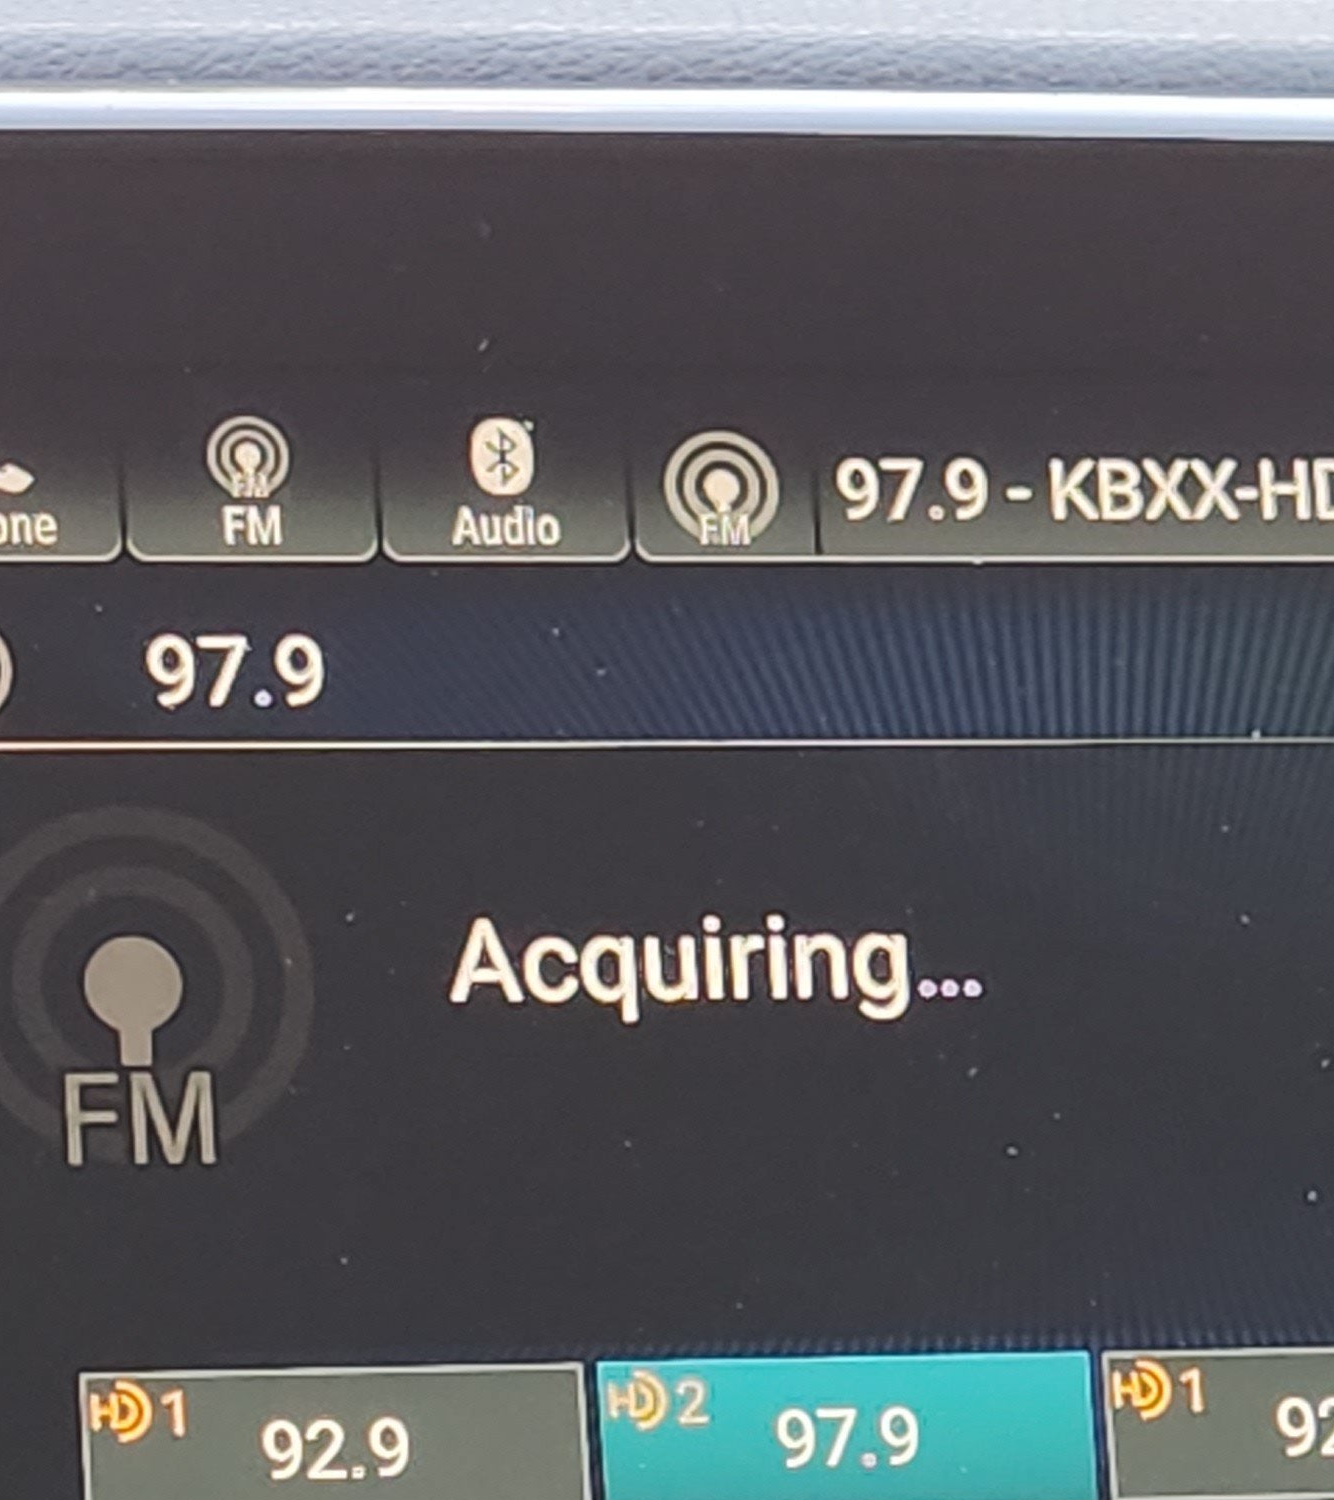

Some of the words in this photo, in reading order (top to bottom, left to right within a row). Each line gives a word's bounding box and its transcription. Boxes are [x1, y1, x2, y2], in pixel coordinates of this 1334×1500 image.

[231, 472, 269, 499] FM
[835, 457, 989, 523] 97.9
[222, 506, 281, 546] FM
[452, 506, 560, 547] Audio
[700, 514, 751, 546] FM
[145, 633, 325, 707] 97.9
[449, 915, 983, 1022] Acquiring...
[65, 1070, 217, 1166] FM
[262, 1418, 410, 1480] 92.9
[775, 1407, 919, 1468] 97.9
